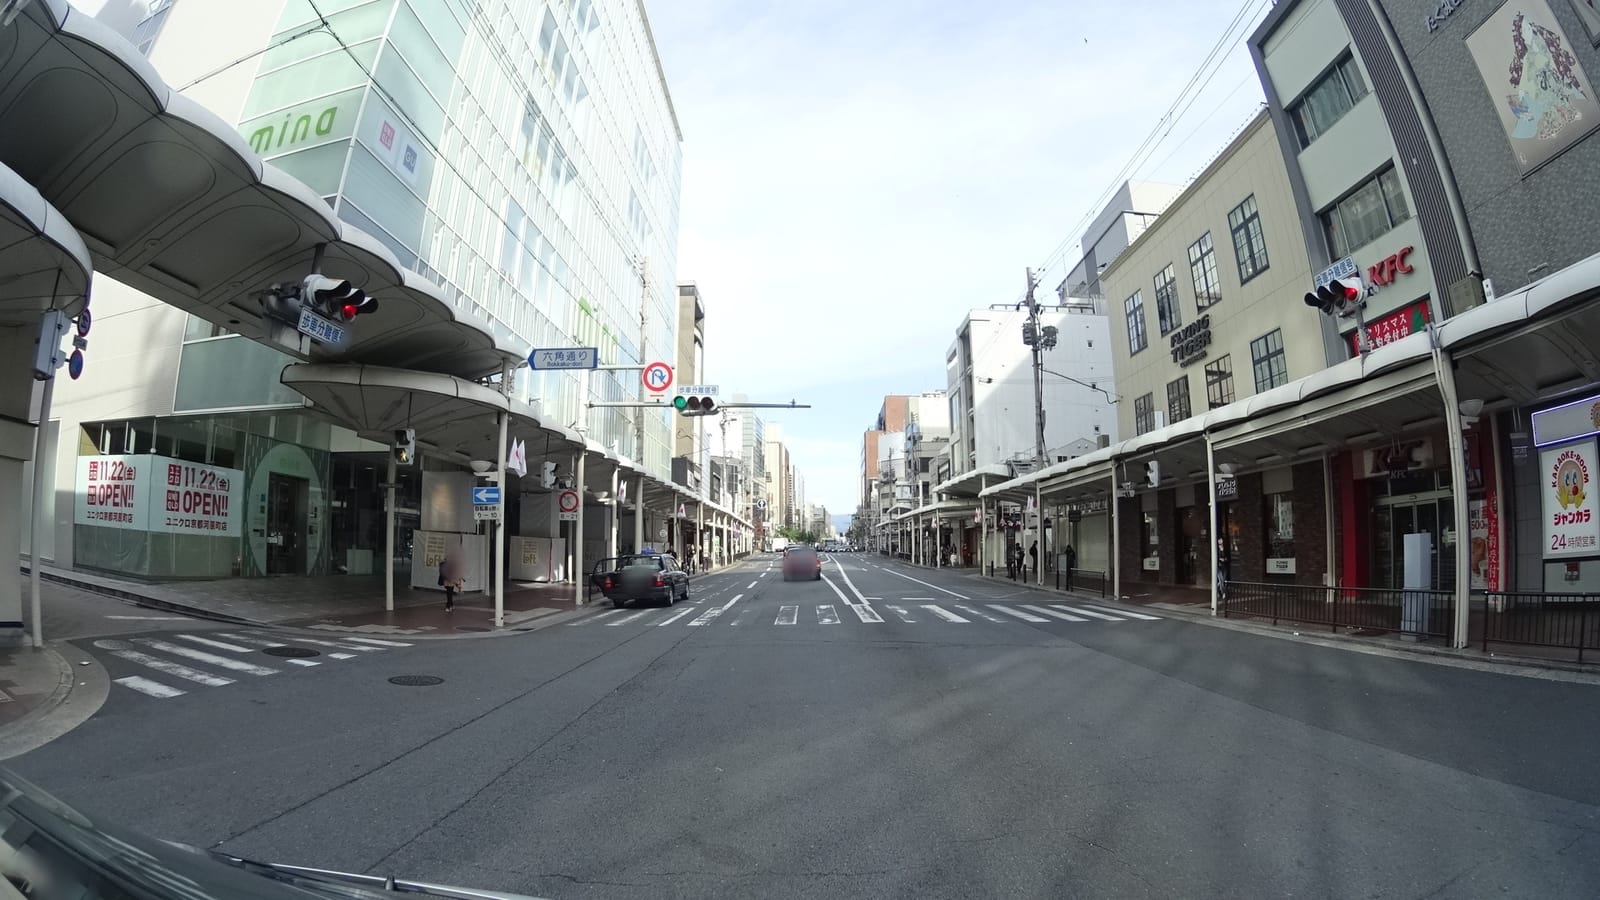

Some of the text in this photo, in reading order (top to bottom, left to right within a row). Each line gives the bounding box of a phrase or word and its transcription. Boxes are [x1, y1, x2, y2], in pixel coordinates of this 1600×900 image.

[250, 106, 338, 154] mina
[1367, 246, 1414, 287] KFC
[1171, 314, 1210, 348] FLYING
[542, 351, 588, 362] 六角通り
[1171, 329, 1211, 363] TIGER
[100, 461, 136, 481] 11.22(金)
[184, 466, 230, 492] 11.22(金)
[99, 484, 135, 508] OPEN!!
[183, 490, 229, 517] OPEN!!
[1553, 509, 1591, 526] ジャンカラ
